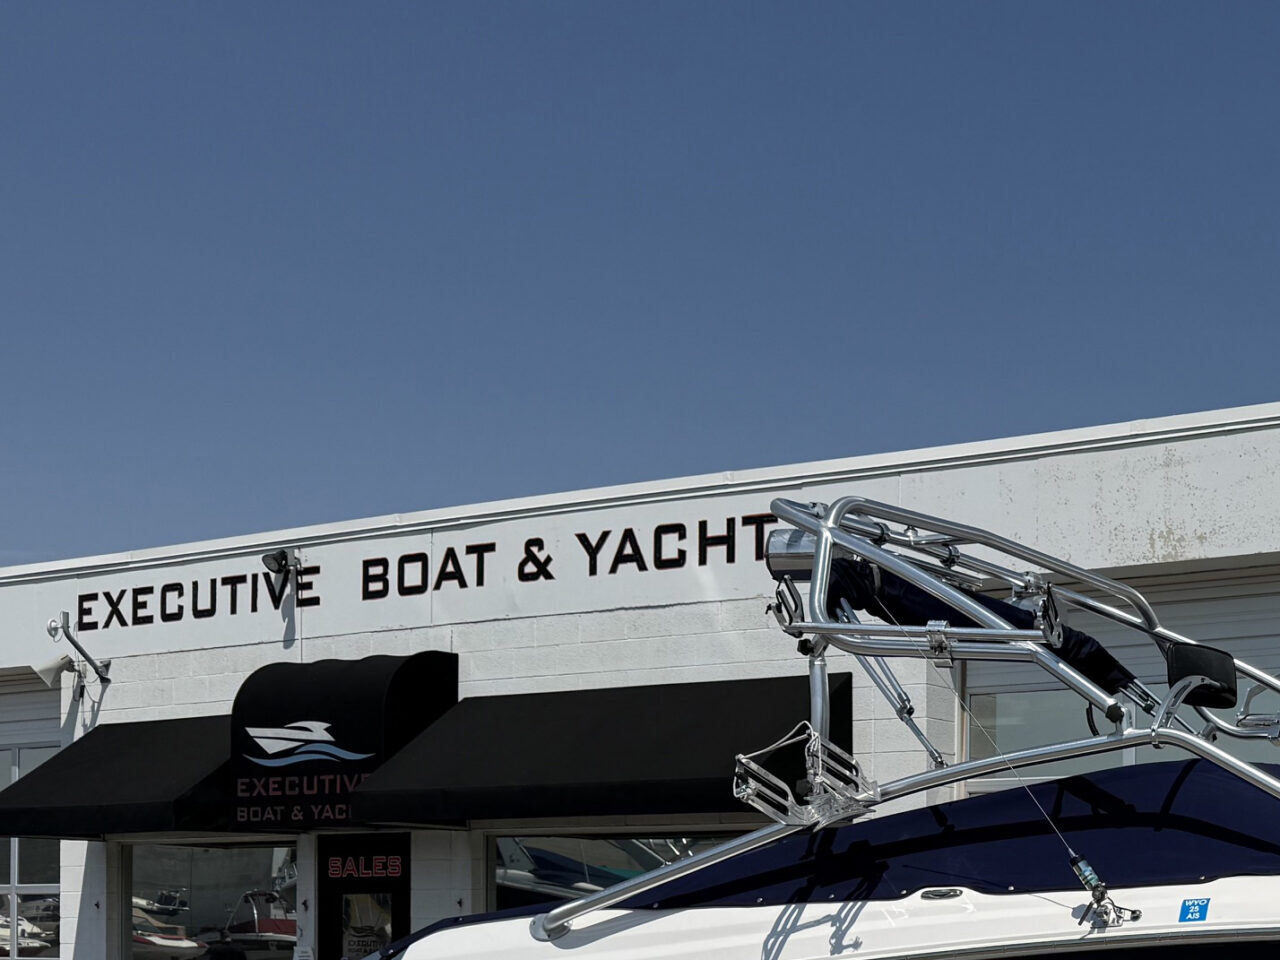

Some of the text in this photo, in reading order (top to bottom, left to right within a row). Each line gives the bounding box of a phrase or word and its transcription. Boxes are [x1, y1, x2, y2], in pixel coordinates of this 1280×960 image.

[77, 512, 779, 632] EXECUTIVE BOAT & YACHT
[237, 806, 285, 822] BOAT
[291, 804, 304, 821] &
[328, 856, 402, 878] SALES
[1186, 912, 1200, 920] AIS
